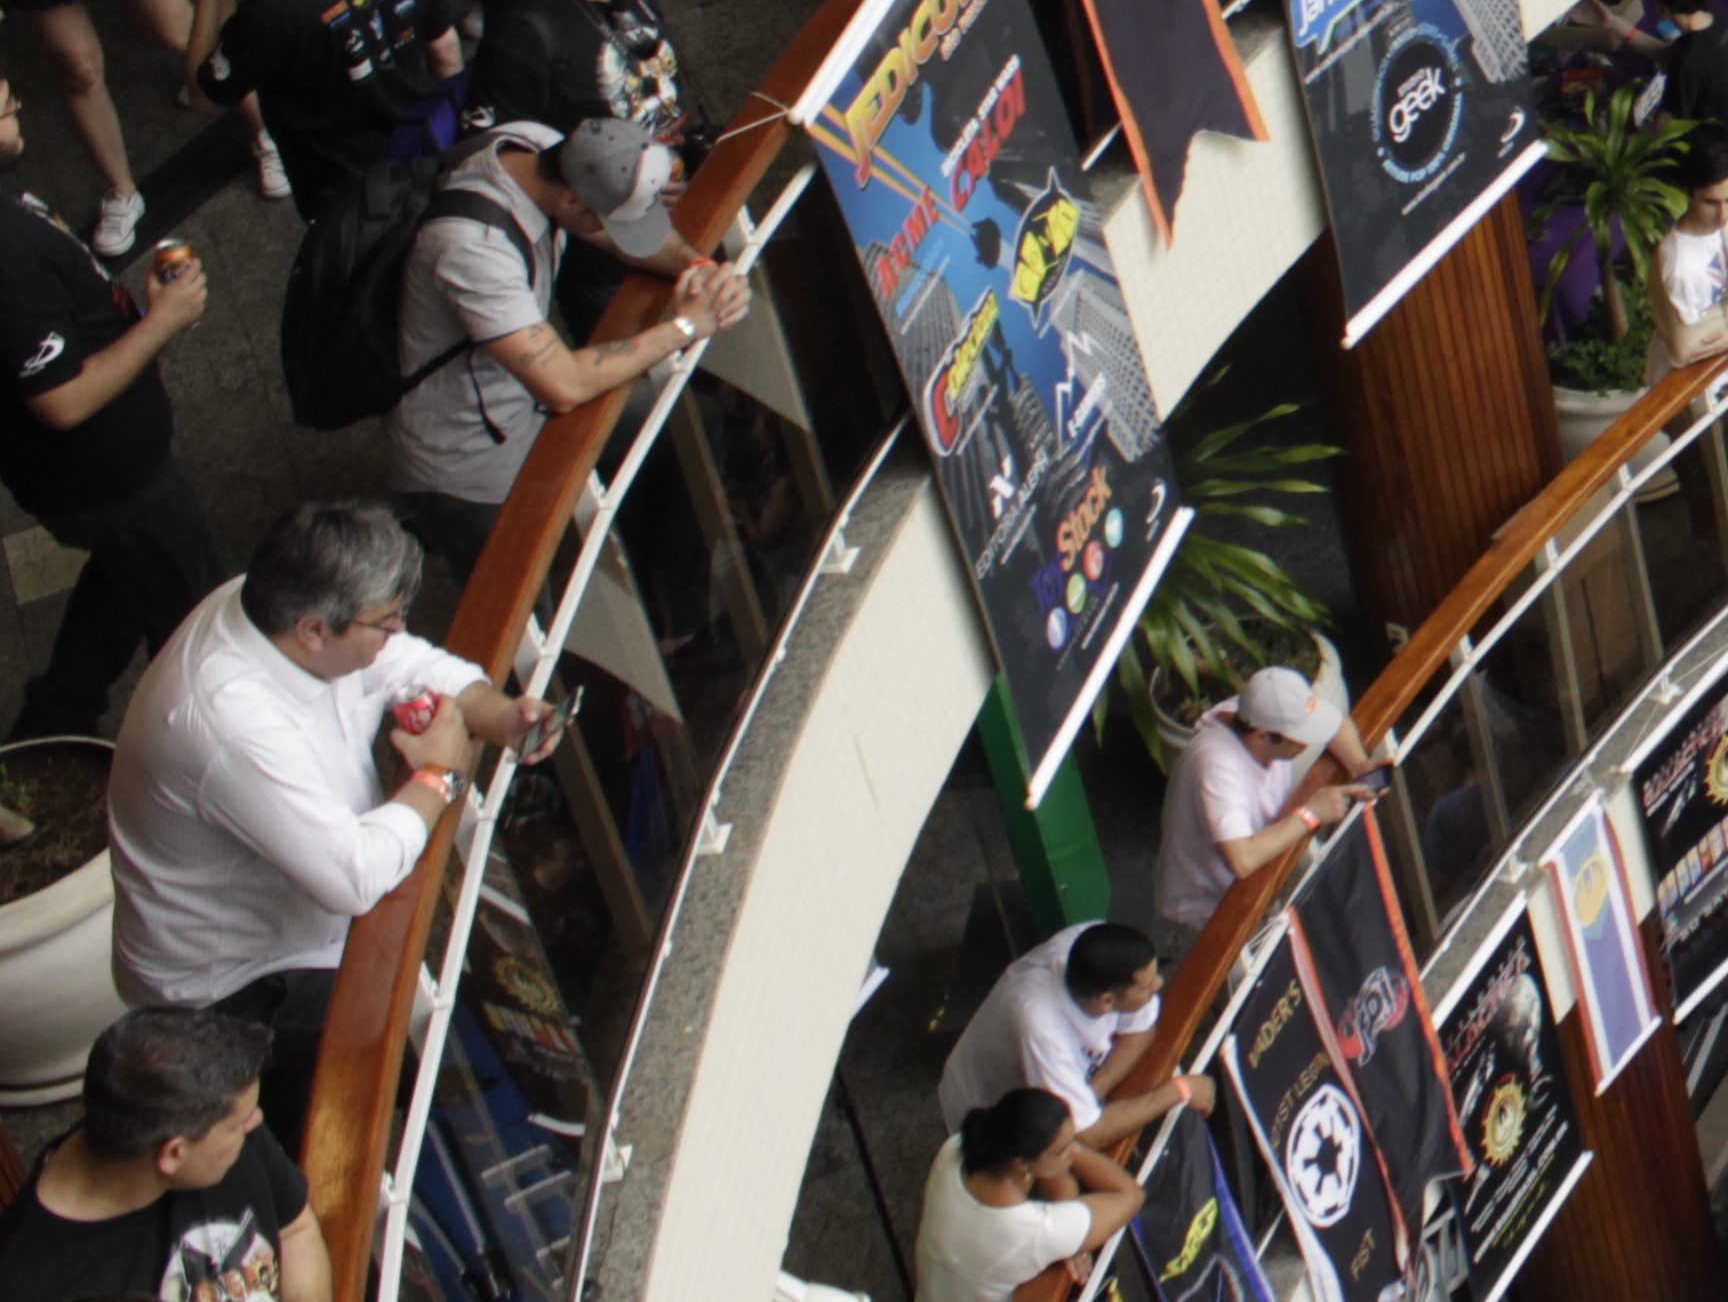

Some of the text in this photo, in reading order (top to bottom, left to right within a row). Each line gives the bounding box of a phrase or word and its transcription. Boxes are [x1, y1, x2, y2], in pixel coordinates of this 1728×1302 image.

[951, 69, 1027, 214] CALOI
[1389, 66, 1446, 143] geek
[875, 185, 940, 299] ACME
[974, 504, 1021, 582] EDITORA
[1017, 446, 1051, 508] ALEPH
[1057, 465, 1112, 573] Stock
[1351, 1227, 1377, 1282] FIST
